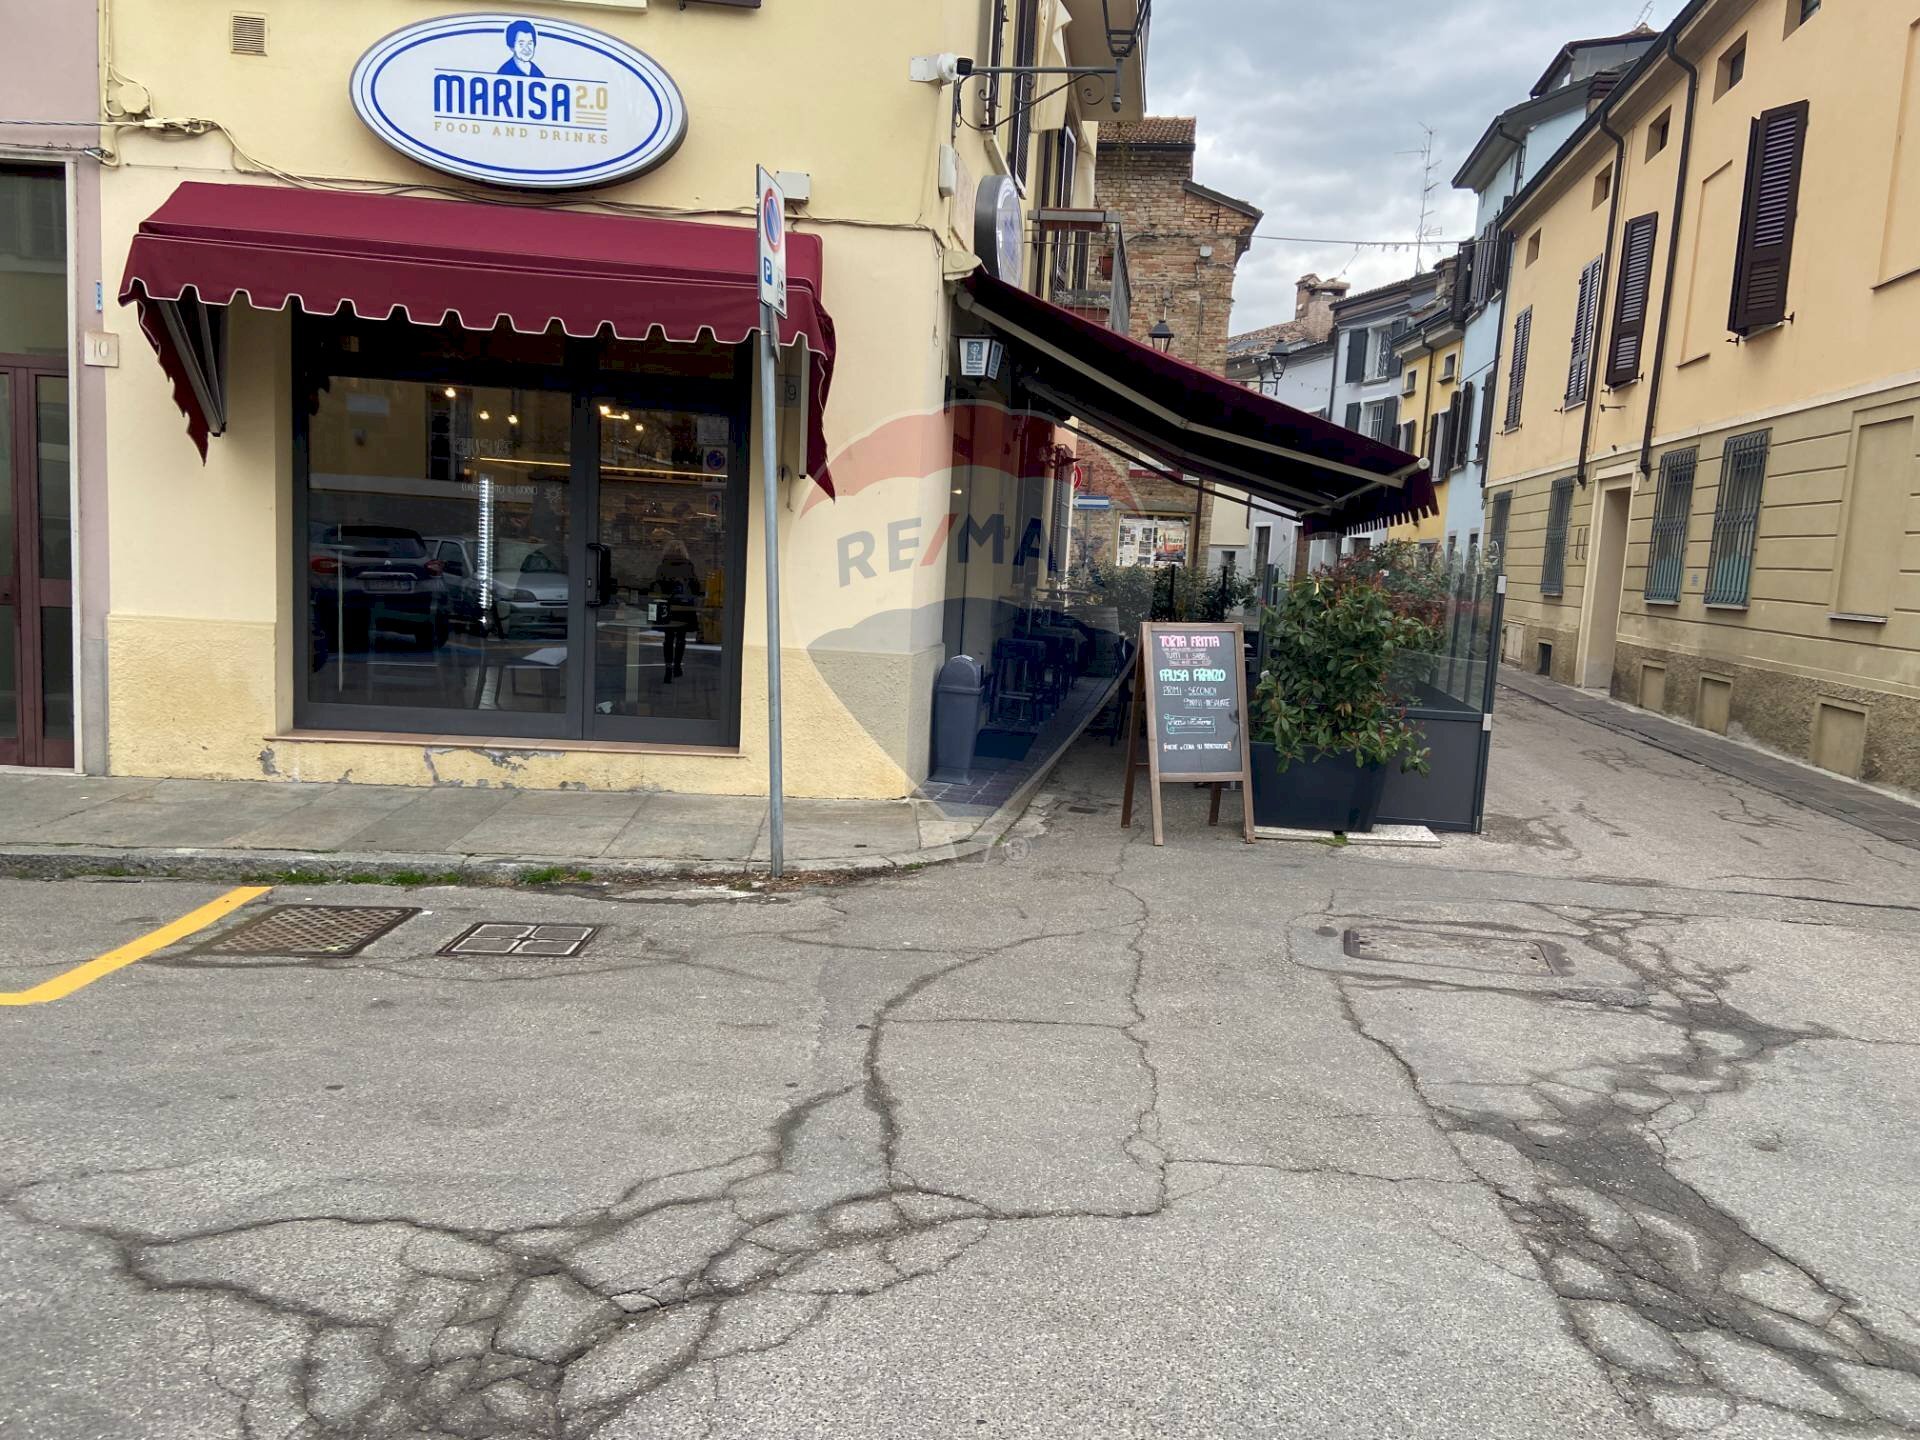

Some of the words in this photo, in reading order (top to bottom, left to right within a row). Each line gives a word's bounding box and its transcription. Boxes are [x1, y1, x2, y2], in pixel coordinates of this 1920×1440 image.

[434, 74, 570, 122] MARISA
[575, 85, 608, 110] 2.0
[434, 121, 481, 134] FOOD
[492, 125, 529, 138] AND
[540, 129, 608, 144] DRINKS
[765, 260, 772, 283] P
[1159, 635, 1187, 647] TORTA
[1190, 635, 1220, 647] FRITTA
[1159, 668, 1189, 682] PAUSA
[1193, 667, 1226, 682] PRANZO
